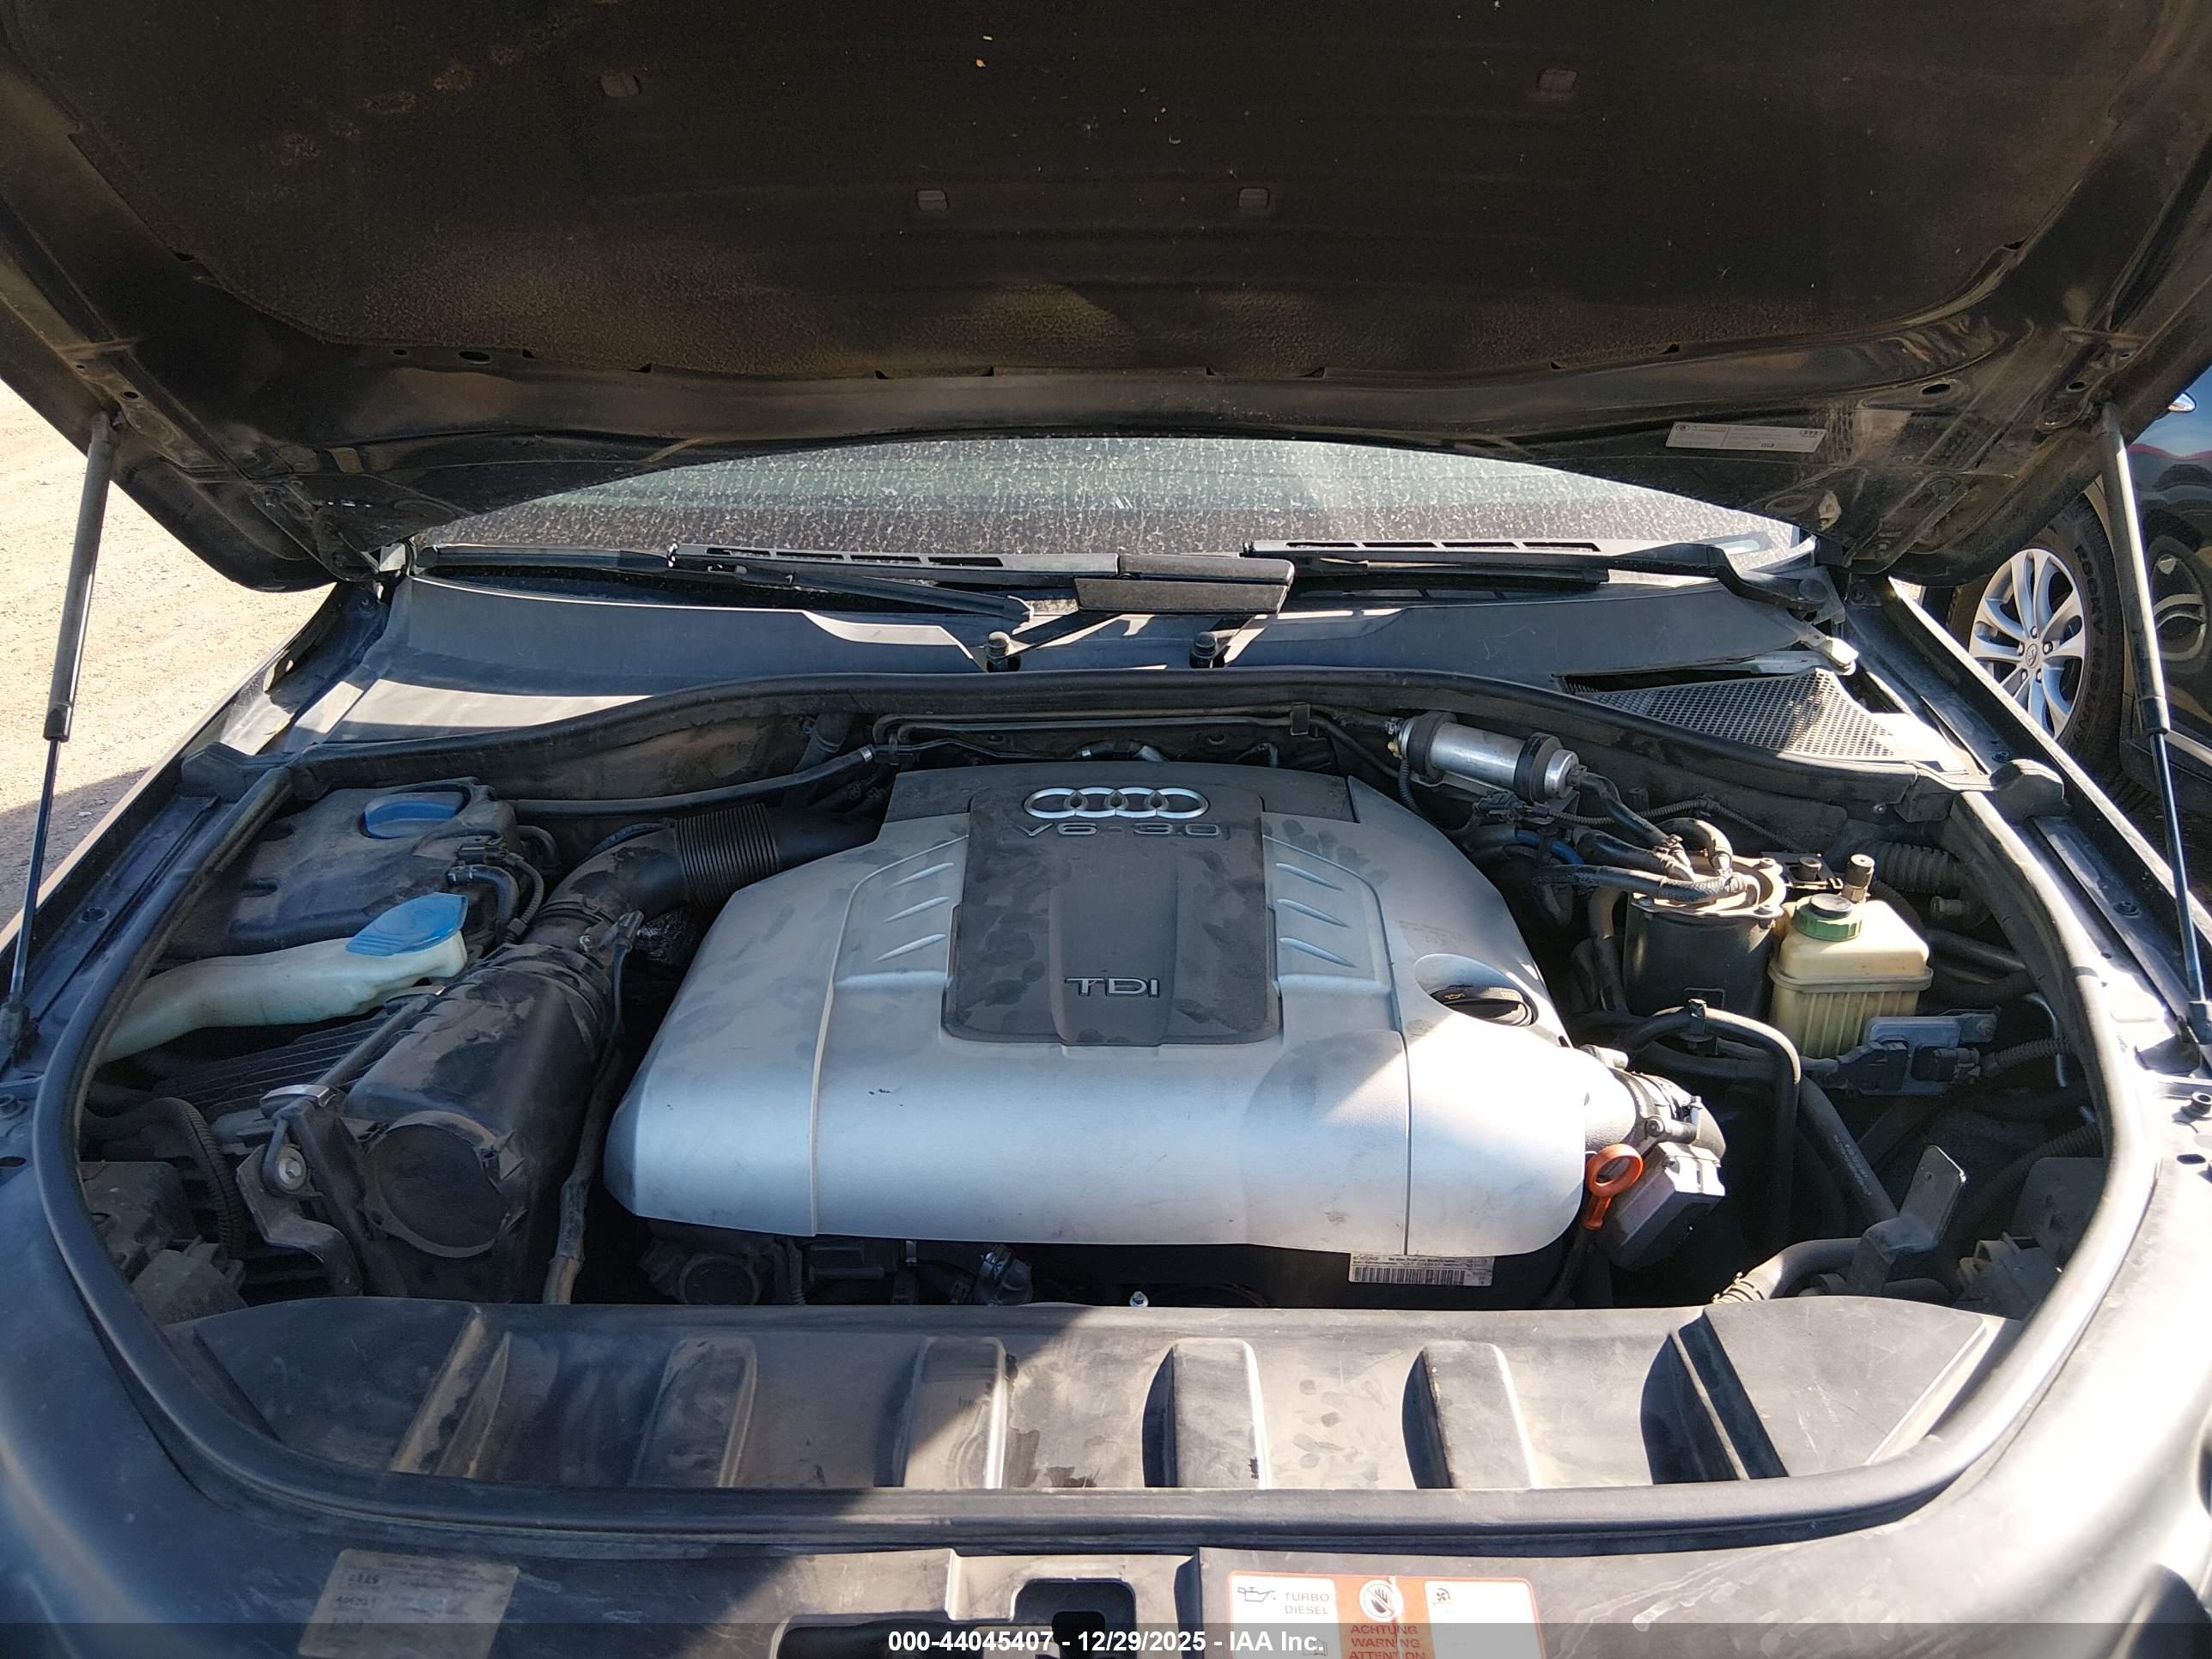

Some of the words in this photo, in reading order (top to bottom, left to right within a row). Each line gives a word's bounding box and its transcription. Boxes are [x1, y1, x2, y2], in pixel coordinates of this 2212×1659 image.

[1016, 822, 1097, 836] V6
[1065, 977, 1159, 996] TDI
[1284, 1591, 1330, 1602] TURBO
[1284, 1605, 1330, 1615] DIESEL
[1350, 1625, 1419, 1635] ACHTUNG
[1351, 1638, 1421, 1648] WARNNG
[1349, 1650, 1426, 1659] ATTENTON
